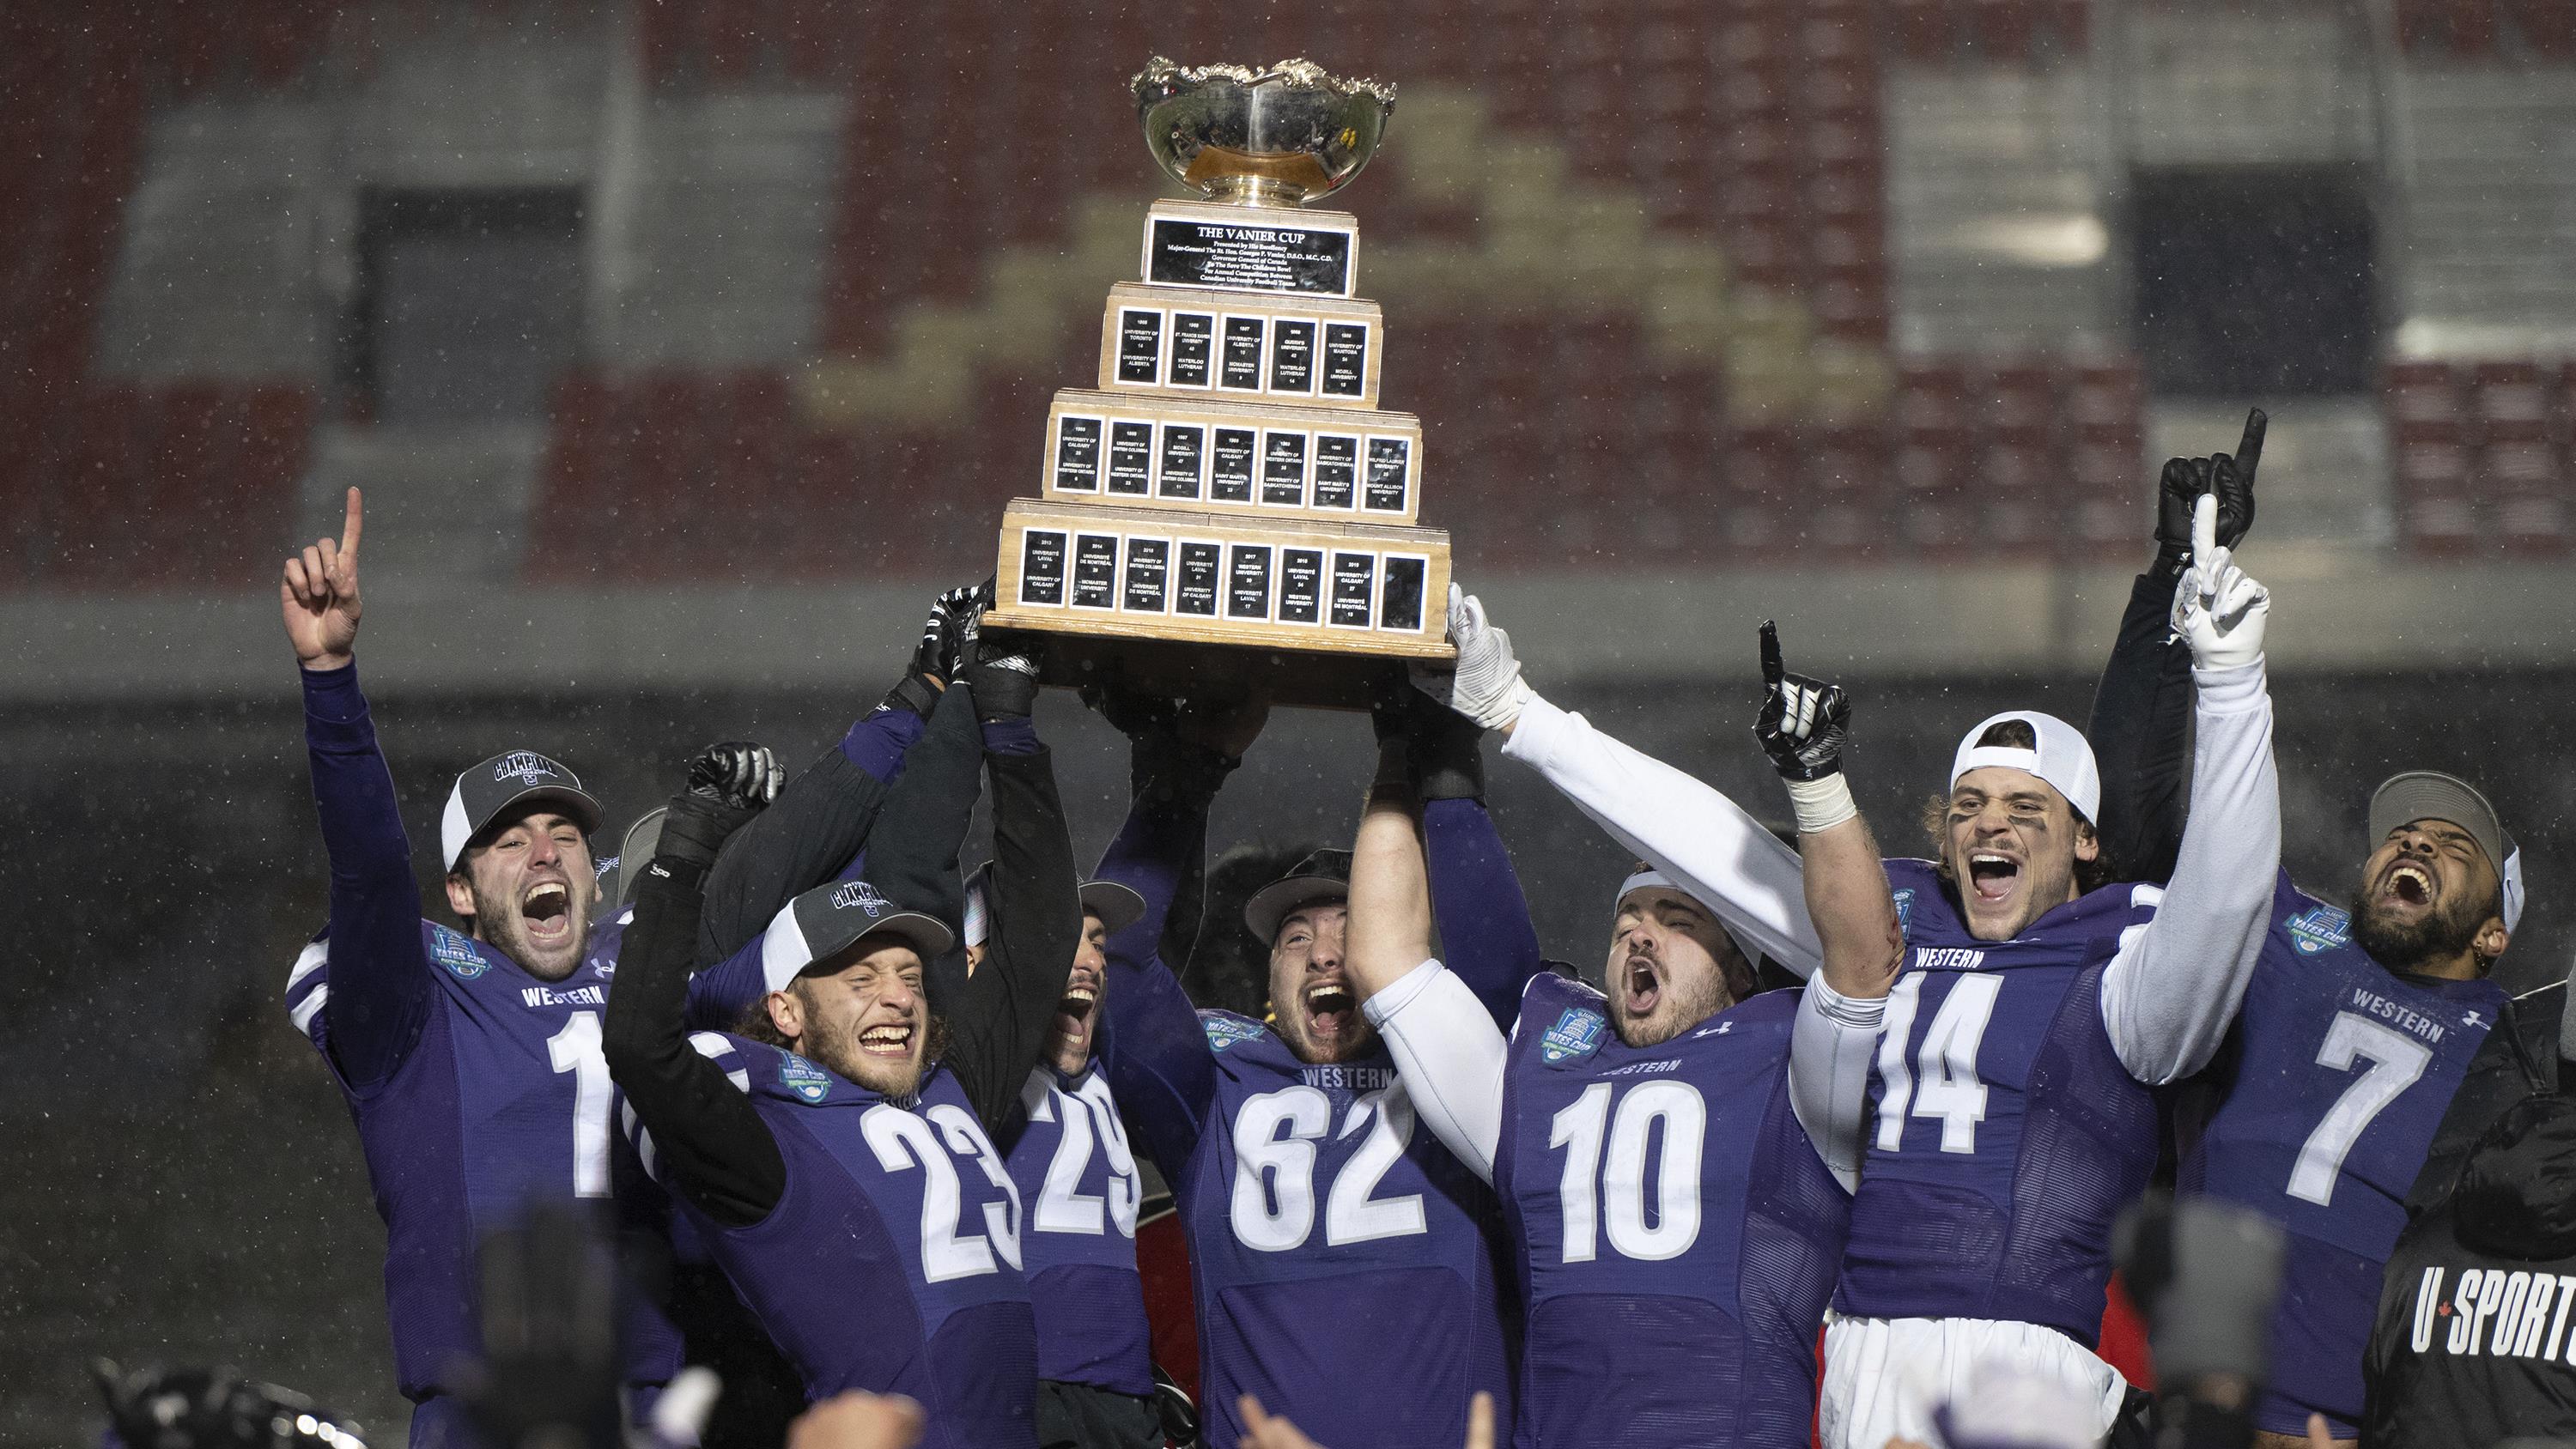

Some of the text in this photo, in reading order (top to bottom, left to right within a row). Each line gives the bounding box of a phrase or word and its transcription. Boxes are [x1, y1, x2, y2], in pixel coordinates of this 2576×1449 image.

[1196, 226, 1305, 244] THE VANIER CUP
[1225, 276, 1255, 285] University
[1916, 948, 1984, 968] WESTERN
[2293, 918, 2325, 936] YATES
[2323, 931, 2347, 943] CUP
[521, 986, 605, 1007] WESTERN
[2351, 988, 2445, 1043] WESTERN
[1547, 1030, 1573, 1046] YATES
[1570, 1040, 1591, 1052] CUP
[1877, 971, 2005, 1154] 14
[547, 1010, 615, 1199] 1
[1301, 1067, 1393, 1090] WESTERN
[2286, 1009, 2434, 1207] 7
[1023, 1064, 1142, 1240] 29
[1230, 1084, 1428, 1252] 62
[1549, 1080, 1707, 1264] 10
[860, 1102, 1024, 1286] 23
[2411, 1267, 2445, 1355] U
